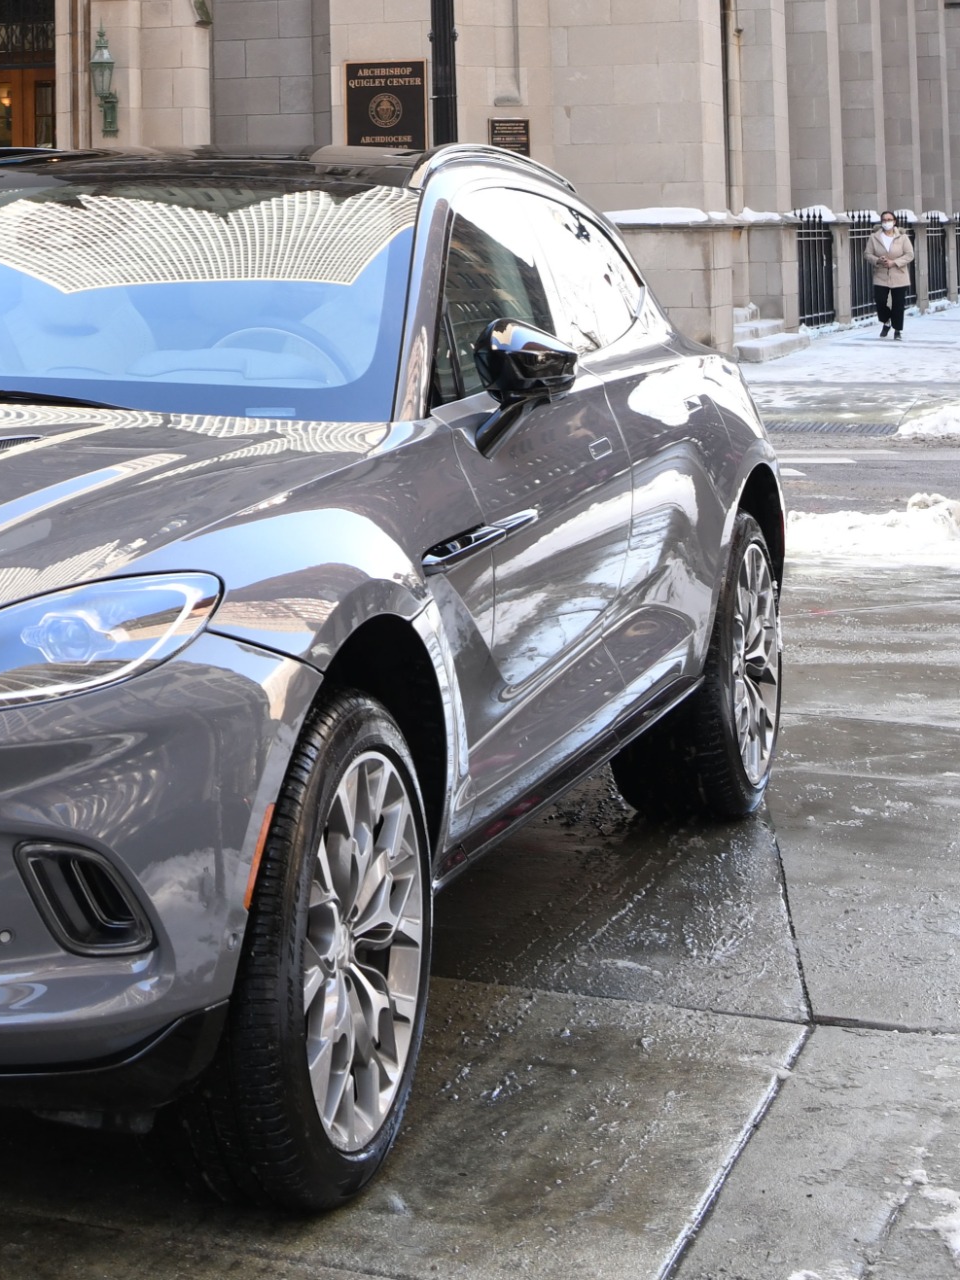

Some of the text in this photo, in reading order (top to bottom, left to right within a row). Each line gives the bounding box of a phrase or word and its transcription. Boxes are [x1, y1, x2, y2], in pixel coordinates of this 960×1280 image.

[357, 67, 412, 77] ARCHBISHOP
[348, 77, 421, 88] QUIGLEY CENTER
[360, 135, 412, 144] ARCHDIOCESE
[288, 880, 301, 966] ZERO
